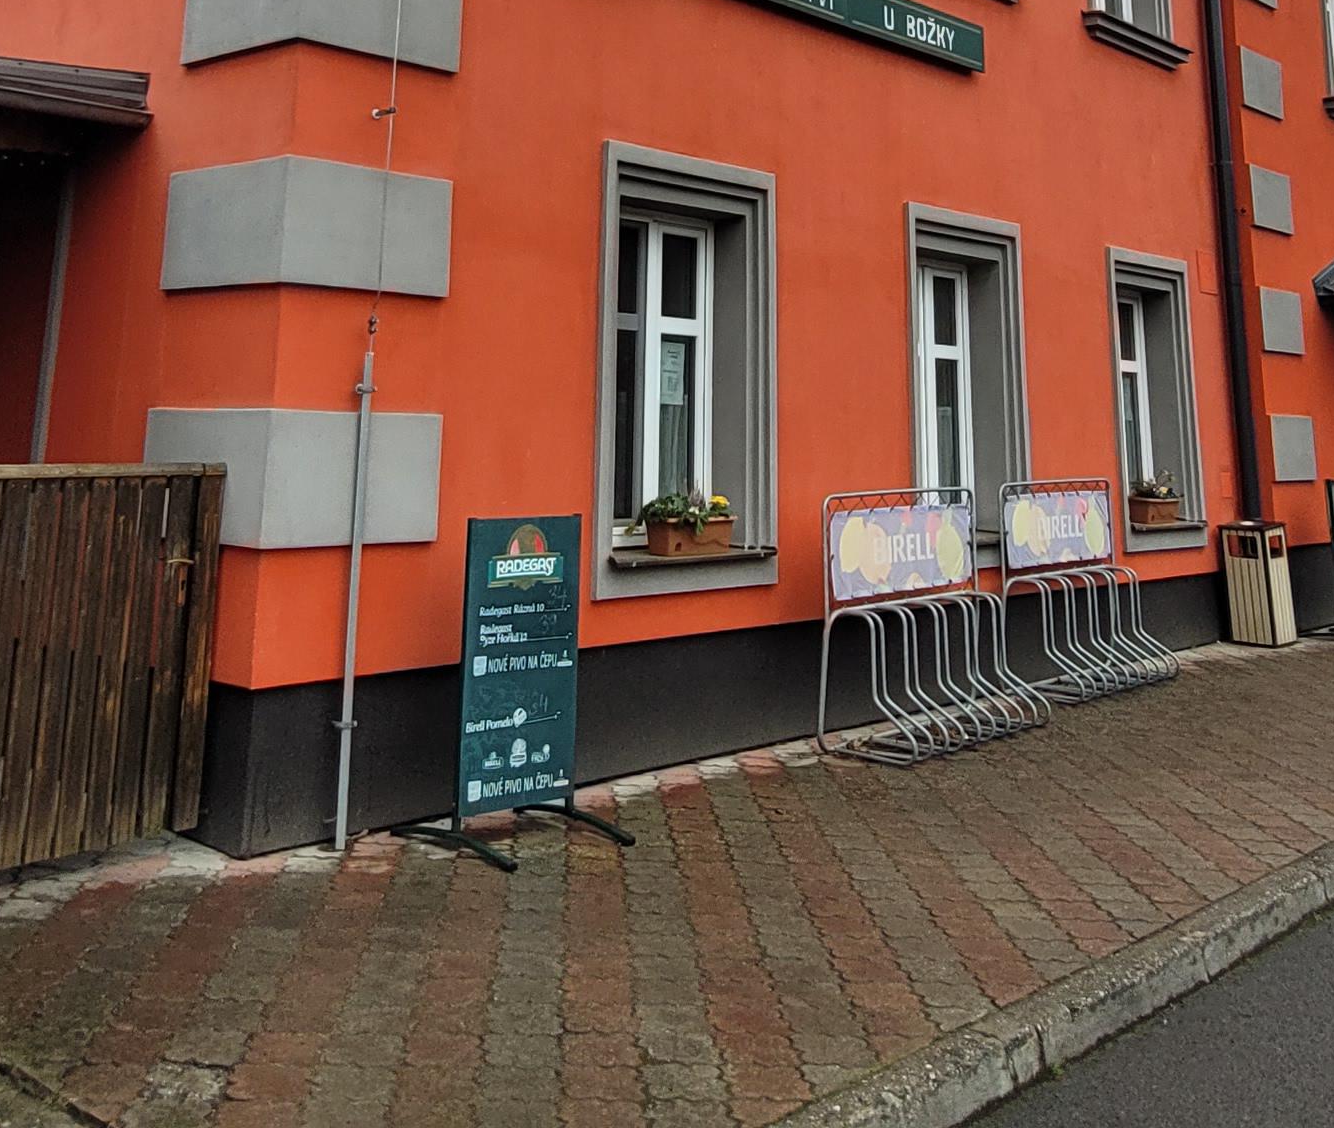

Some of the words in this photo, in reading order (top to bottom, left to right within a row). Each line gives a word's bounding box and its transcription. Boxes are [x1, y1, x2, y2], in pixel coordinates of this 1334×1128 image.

[883, 4, 896, 31] U
[906, 14, 955, 52] BOŽKY
[1037, 513, 1084, 543] BIRELL
[873, 531, 935, 565] BIRELL
[496, 556, 557, 579] RADEGAST
[487, 653, 508, 673] NOVÉ
[508, 655, 527, 671] PIVO
[528, 655, 538, 670] NA
[539, 650, 558, 669] ČEPU
[482, 776, 503, 798] NOVÉ
[504, 777, 522, 794] PIVO
[523, 776, 534, 792] NA
[535, 771, 554, 790] ČEPU
